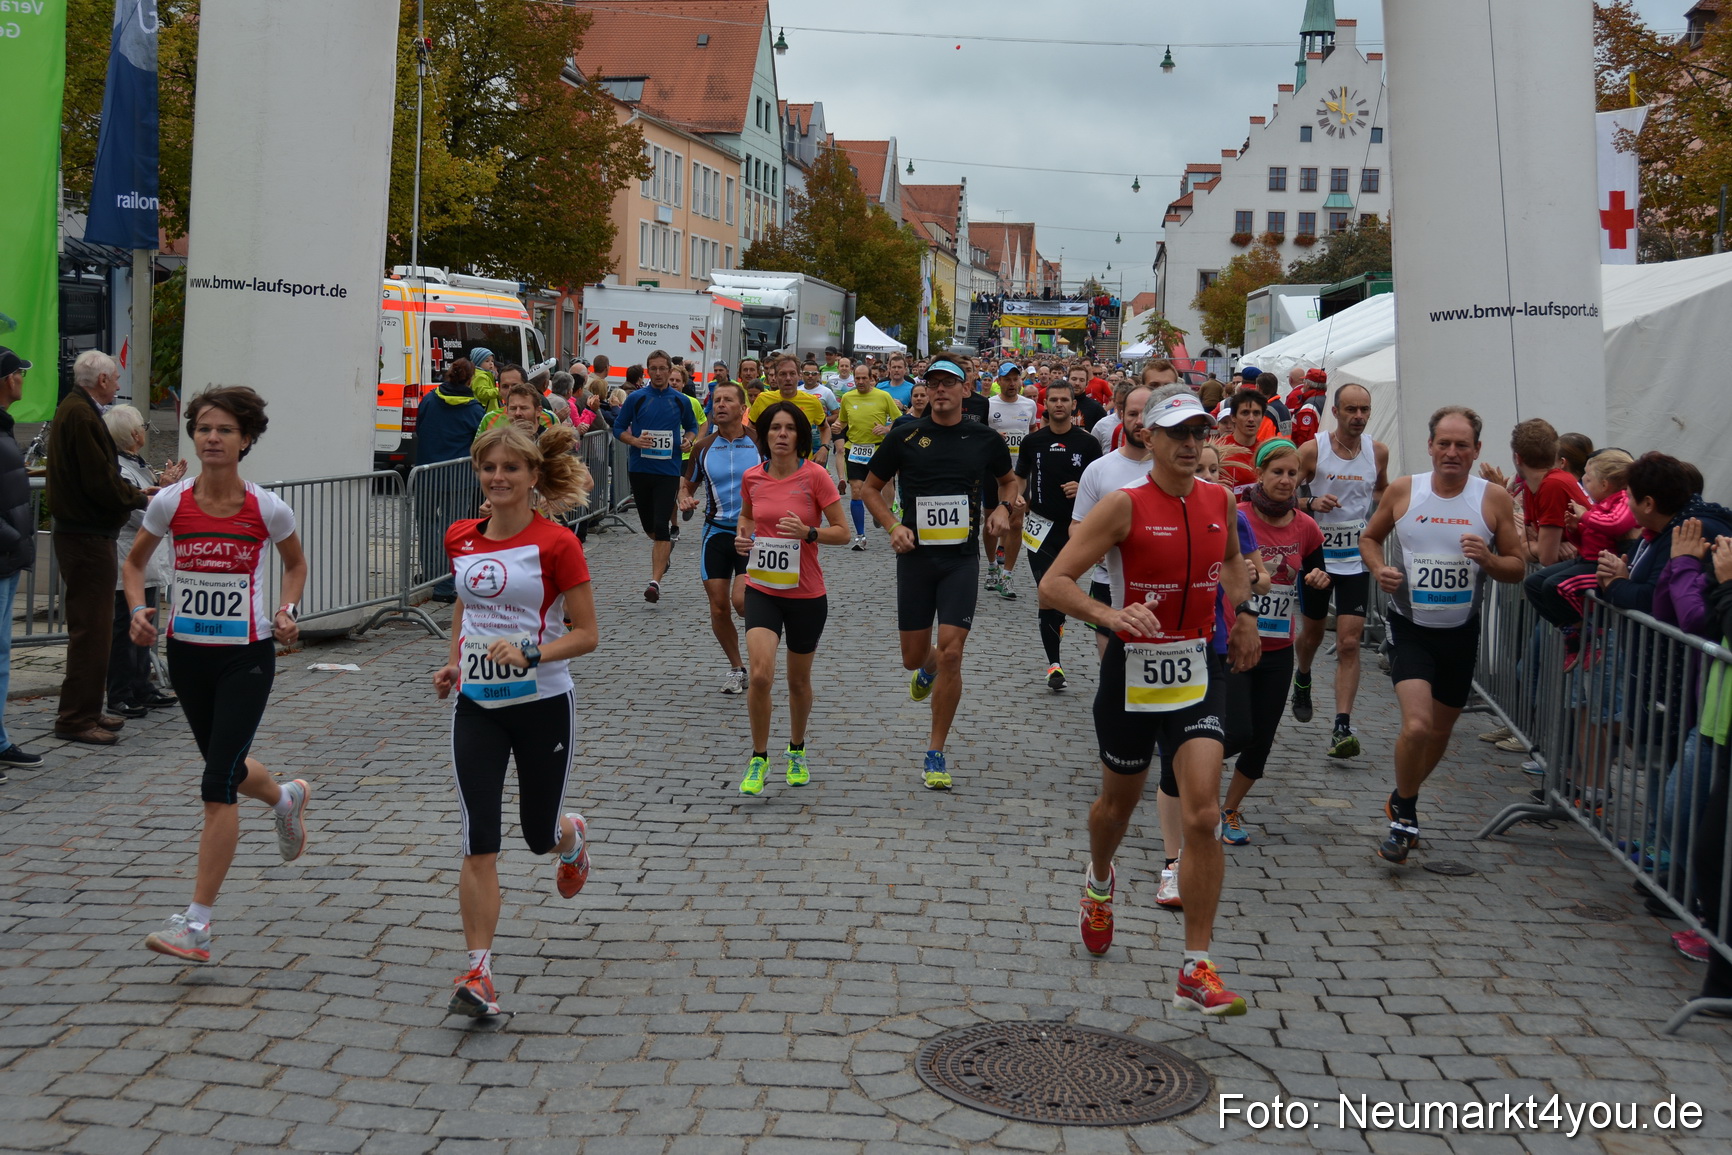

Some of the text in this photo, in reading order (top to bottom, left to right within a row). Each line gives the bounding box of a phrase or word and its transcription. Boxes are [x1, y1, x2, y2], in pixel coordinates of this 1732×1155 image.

[189, 275, 348, 299] www.bmw-laufsport.de
[1429, 301, 1599, 322] www.bmw-laufsport.de
[638, 321, 680, 330] Bayerisches
[1028, 318, 1058, 326] START
[637, 338, 657, 346] Kreuz
[852, 446, 873, 457] 2089
[927, 508, 960, 527] 504
[1430, 517, 1473, 526] KLEBL
[176, 542, 235, 558] MUSCAT
[177, 558, 232, 569] Road Runners
[757, 549, 789, 570] 506
[176, 577, 236, 588] PARTL Neumarkt
[1417, 567, 1469, 589] 2058
[1130, 581, 1179, 589] MEDERER
[181, 588, 243, 617] 2002
[1427, 594, 1457, 603] Roland
[195, 623, 222, 636] Birgit
[1127, 647, 1194, 656] PARTL Neumarkt
[1143, 657, 1192, 685] 503
[483, 686, 511, 699] Steffi
